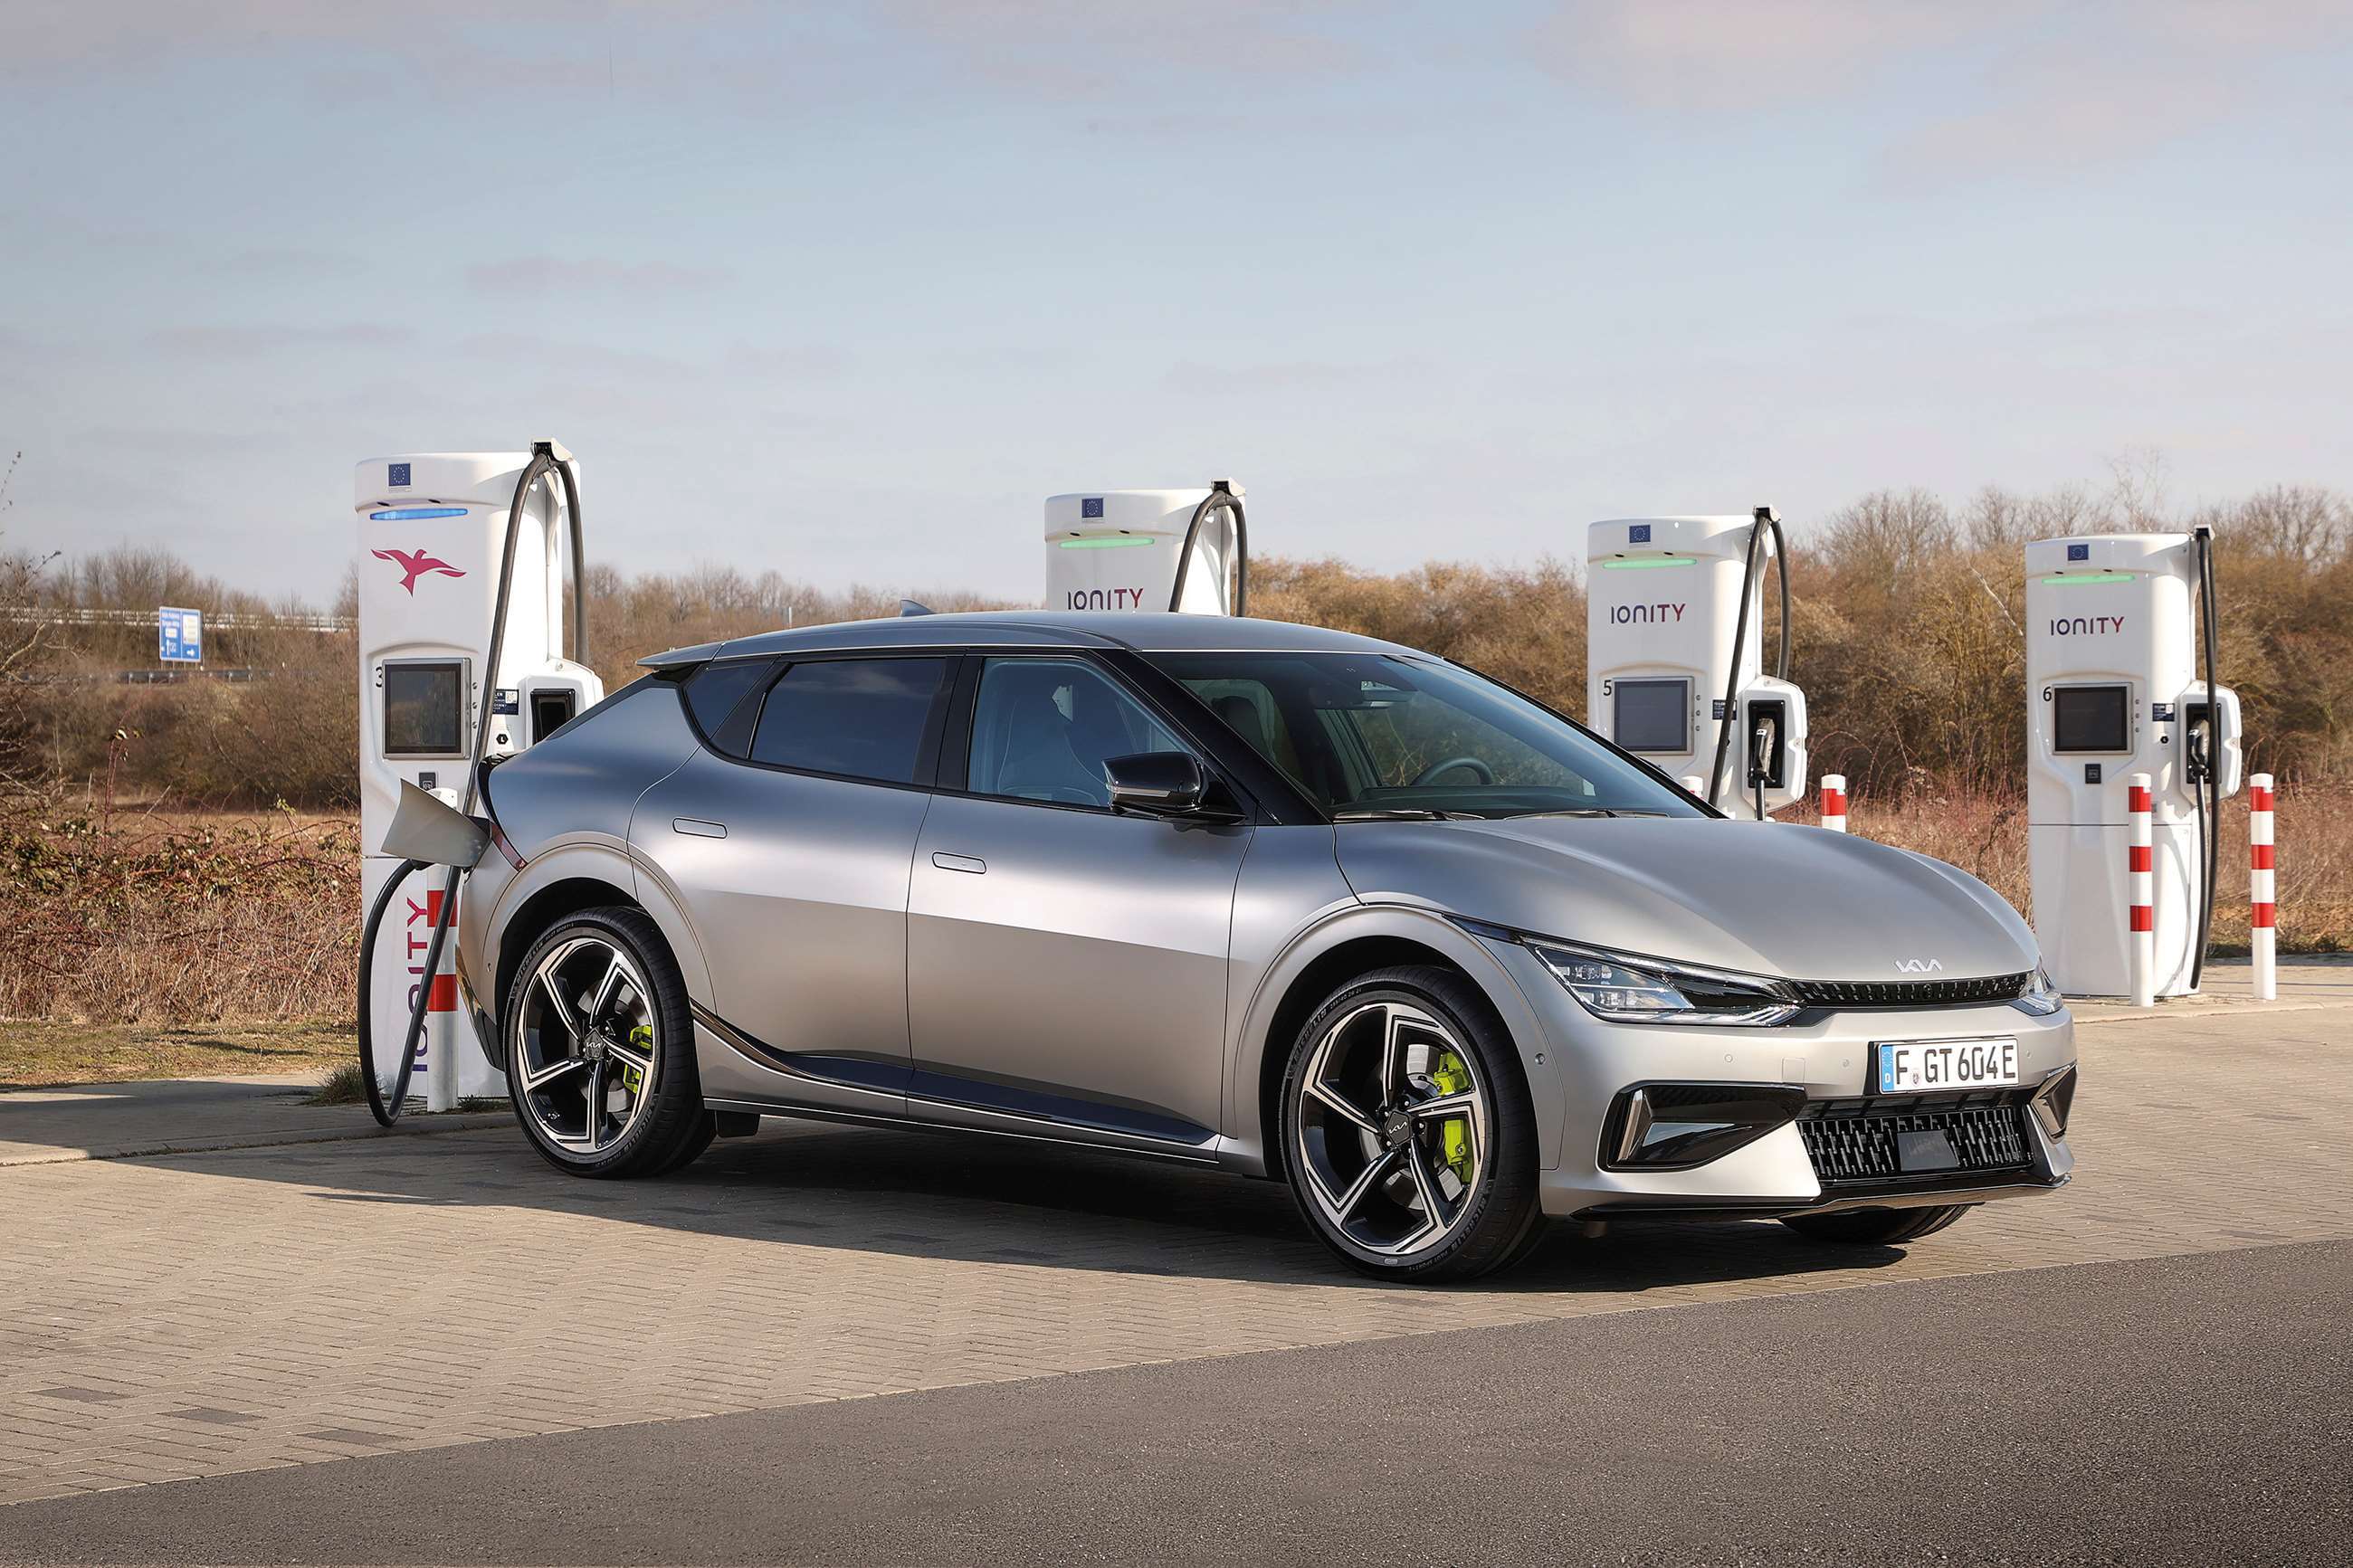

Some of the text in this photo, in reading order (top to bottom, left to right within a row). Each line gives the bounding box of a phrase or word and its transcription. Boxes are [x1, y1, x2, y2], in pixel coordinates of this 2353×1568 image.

[1068, 588, 1144, 611] IONITY
[1611, 603, 1686, 624] IONITY
[2051, 616, 2125, 636] IONITY
[1603, 679, 1612, 697] 5
[2043, 686, 2052, 702] 6
[1894, 958, 1943, 974] KIA
[1896, 1050, 1910, 1085] F
